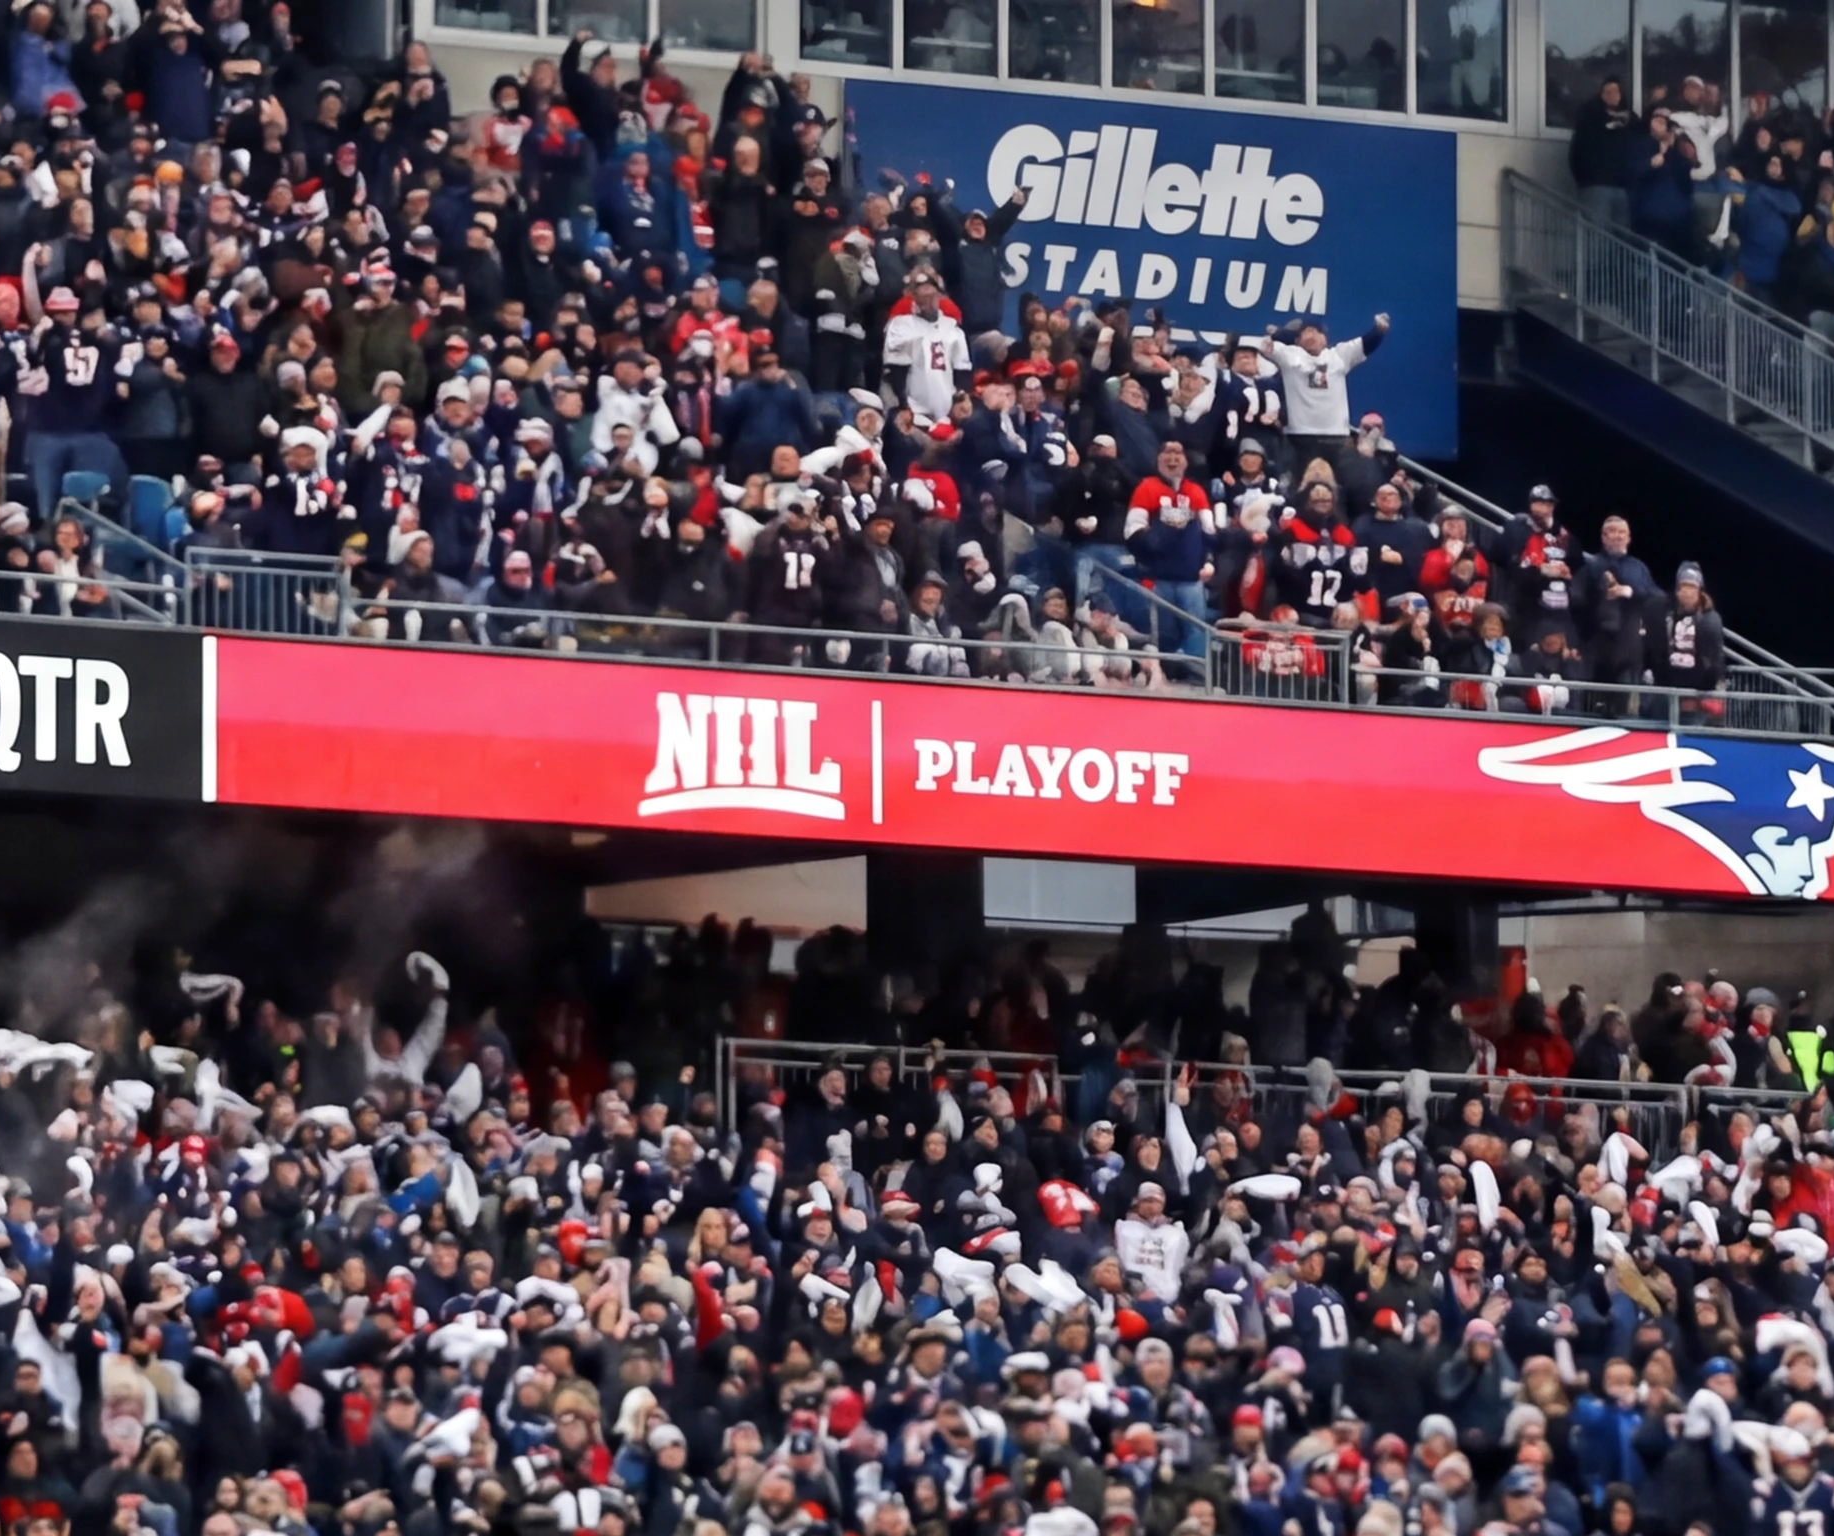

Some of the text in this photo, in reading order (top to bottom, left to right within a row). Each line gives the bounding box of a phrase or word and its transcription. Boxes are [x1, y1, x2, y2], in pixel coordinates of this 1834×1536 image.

[987, 124, 1325, 247] Gillette
[1002, 241, 1328, 316] STADIUM
[644, 691, 842, 794] NHL
[913, 738, 1190, 806] PLAYOFF
